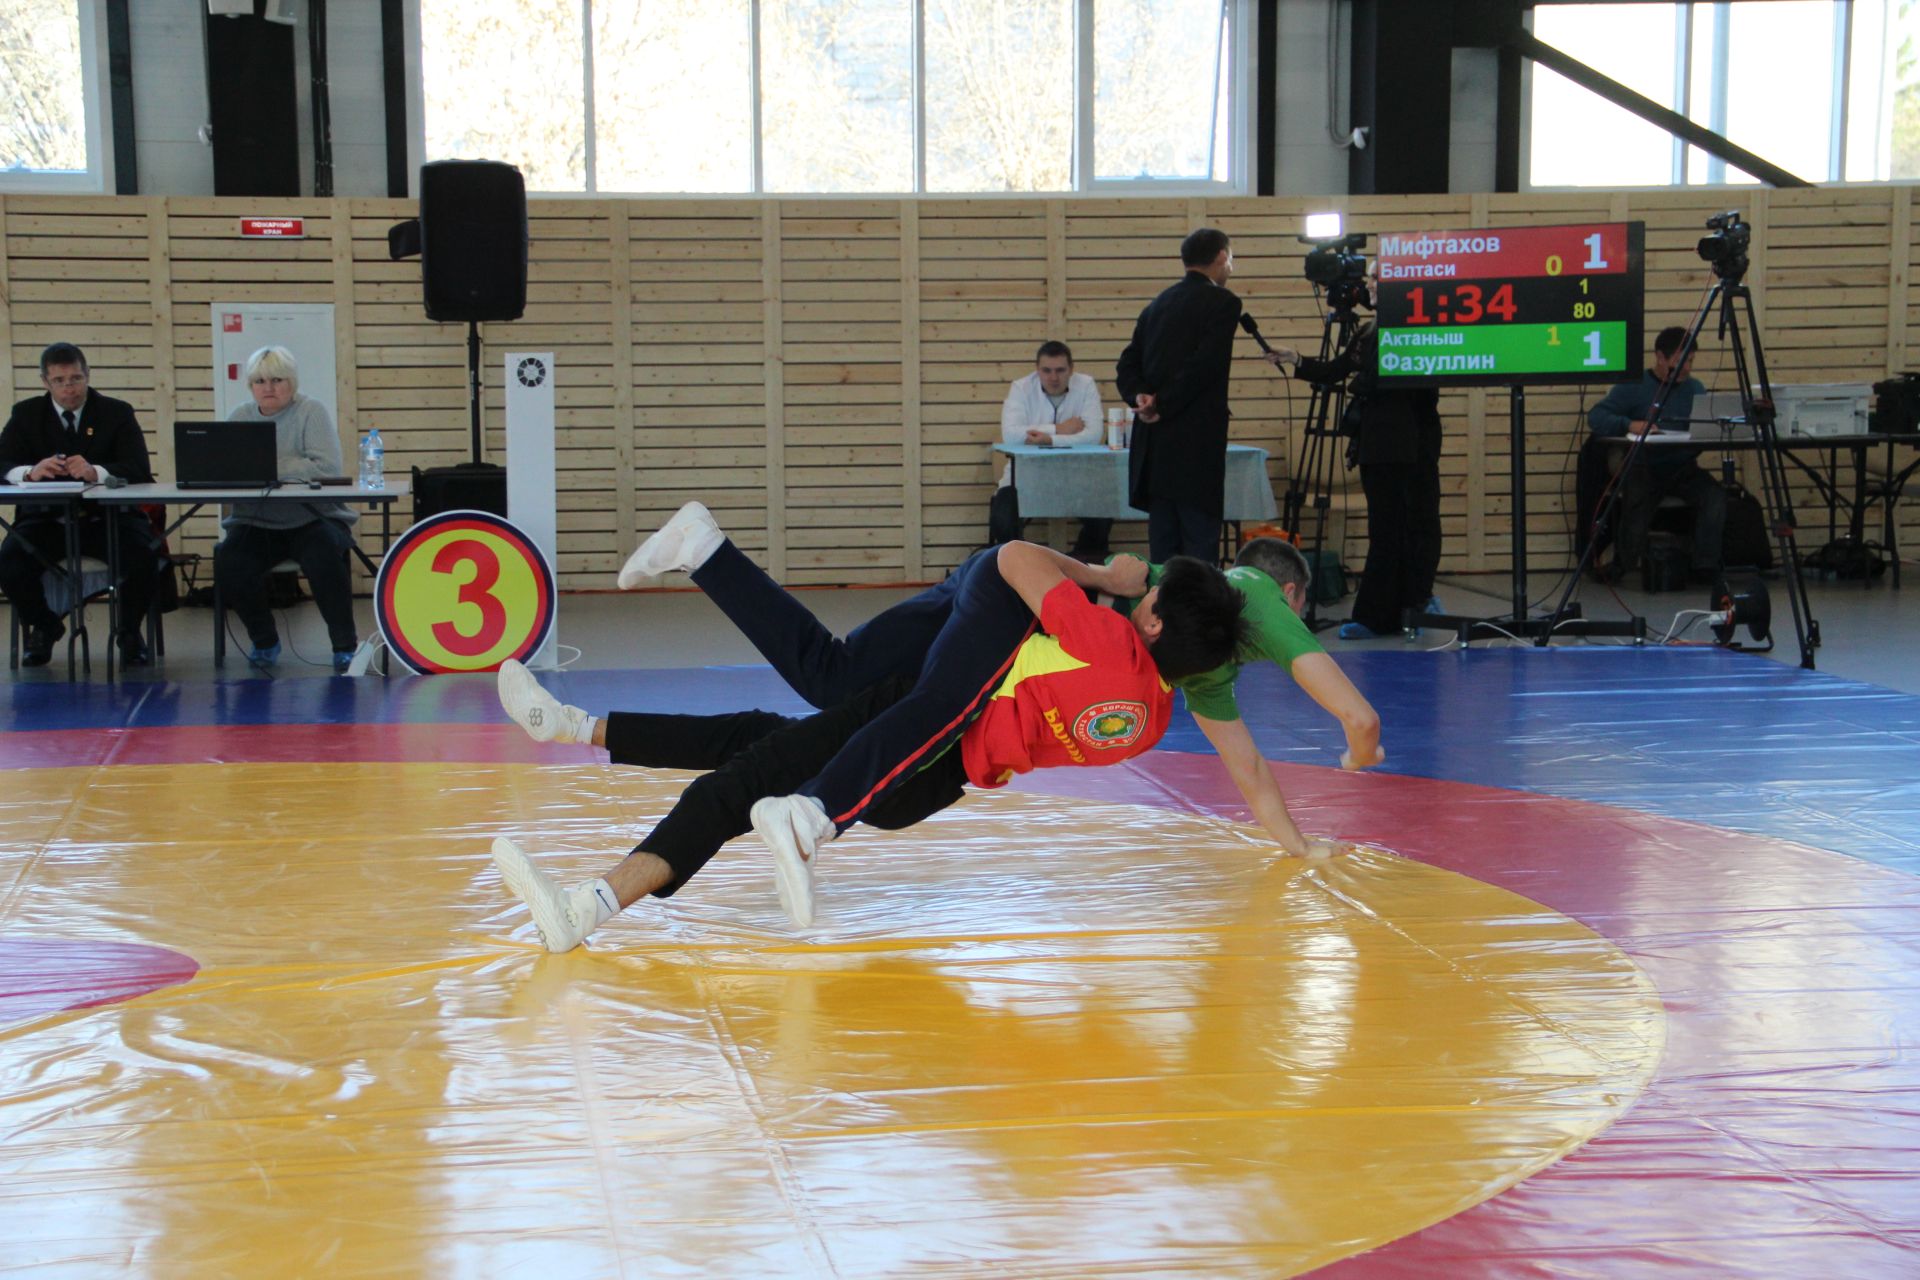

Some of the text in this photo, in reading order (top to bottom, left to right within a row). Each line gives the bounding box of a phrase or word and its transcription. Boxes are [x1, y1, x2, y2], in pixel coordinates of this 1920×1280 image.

[252, 220, 292, 228] ПОЖАРНЫЙ
[1380, 236, 1501, 259] Мифтахов
[1583, 233, 1608, 269] 1
[1380, 262, 1456, 279] Балтаси
[1545, 255, 1563, 276] 0
[1579, 278, 1589, 294] 1
[1405, 284, 1518, 324] 1:34
[1573, 302, 1595, 319] 80
[1380, 331, 1464, 347] Актаныш
[1547, 326, 1561, 346] 1
[1583, 331, 1607, 366] 1
[1380, 351, 1495, 375] Фазуллин
[431, 539, 507, 656] 3
